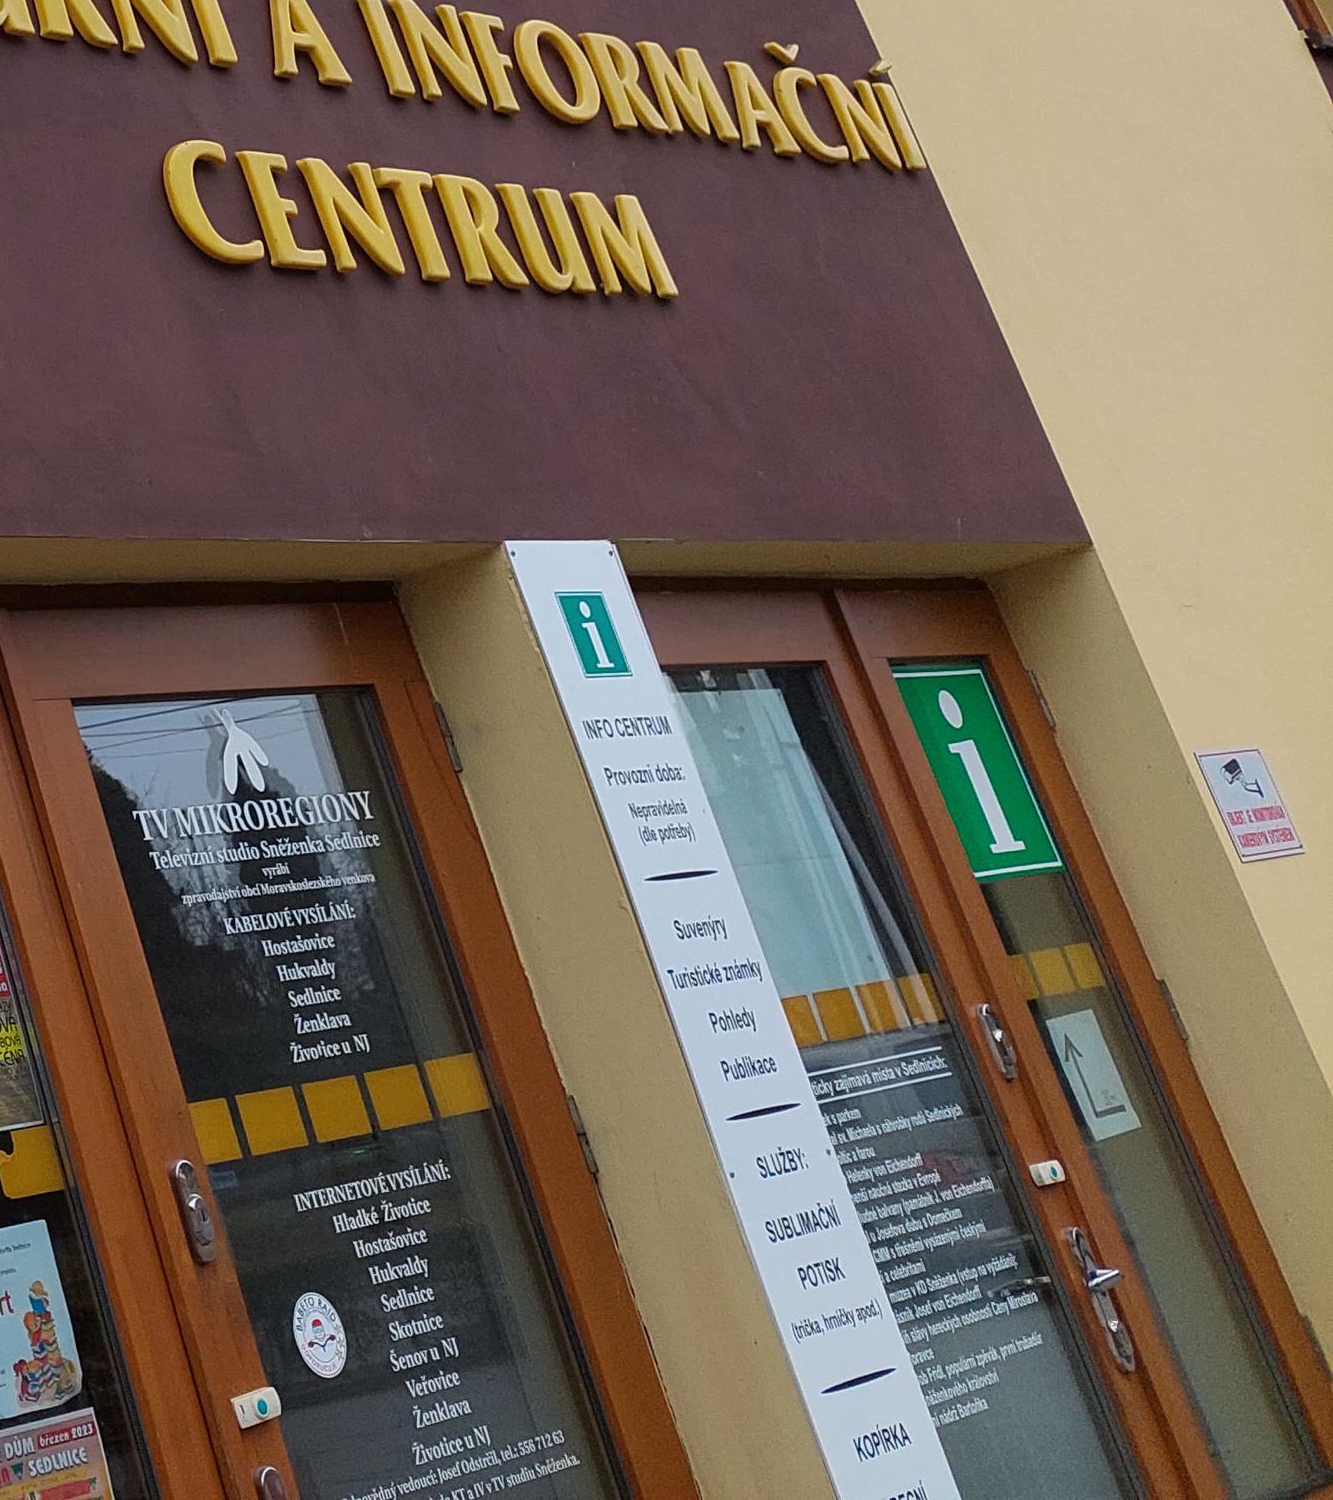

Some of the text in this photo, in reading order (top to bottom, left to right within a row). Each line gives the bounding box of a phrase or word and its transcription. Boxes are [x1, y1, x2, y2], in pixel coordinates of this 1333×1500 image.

[163, 140, 679, 299] CENTRUM
[582, 715, 673, 740] INFO CENTRUM
[603, 762, 686, 787] Provozní doba:
[132, 790, 375, 842] TV MIKROREGIONY
[627, 798, 688, 821] Nepravidelná
[148, 829, 382, 870] Televizní studio Sněženka Sedlnice
[637, 821, 696, 846] (dle potřeby)
[181, 884, 241, 905] zpravodajství
[240, 882, 262, 899] obcí
[261, 873, 341, 896] Moravskoslezského
[223, 899, 357, 935] KABELOVÉ VYSÍLÁNÍ:
[673, 915, 728, 941] Suvenýry
[261, 932, 336, 957] Hostašovice
[276, 958, 336, 982] Hukvaldy
[667, 957, 763, 990] Turistické známky
[287, 985, 342, 1008] Sedlnice
[293, 1012, 352, 1035] Ženklava
[708, 1005, 757, 1034] Pohledy
[289, 1034, 371, 1063] Životice u NJ
[720, 1054, 778, 1082] Publikace
[756, 1146, 810, 1179] SLUŽBY:
[293, 1158, 452, 1212] INTERNETOVÉ VYSÍLÁNÍ:
[332, 1197, 432, 1234] Hladké Životice
[764, 1198, 842, 1244] SUBLIMAČNÍ
[352, 1227, 429, 1259] Hostašovice
[368, 1255, 429, 1285] Hukvaldy
[797, 1256, 846, 1291] POTISK
[380, 1285, 436, 1313] Sedlnice
[388, 1313, 445, 1342] Skotnice
[790, 1313, 825, 1344] (trička,
[823, 1305, 857, 1331] hrníčky
[855, 1299, 883, 1324] apod.)
[389, 1336, 460, 1372] Šenov u NJ
[405, 1370, 461, 1398] Veřovice
[412, 1399, 473, 1429] Ženklava
[4, 1435, 36, 1461] DŮM
[39, 1432, 70, 1448] březen
[71, 1423, 94, 1440] 2023
[412, 1424, 492, 1466] Životice u NJ
[852, 1422, 913, 1462] KOPÍRKA
[27, 1446, 89, 1478] SEDLNICE
[396, 1468, 439, 1495] vedoucí:
[437, 1465, 462, 1485] Josef
[461, 1450, 502, 1475] Odstrčil,
[518, 1440, 536, 1456] 556
[534, 1433, 553, 1451] 712
[490, 1474, 507, 1493] TV
[506, 1466, 537, 1488] studiu
[534, 1452, 581, 1478] Sněženka.
